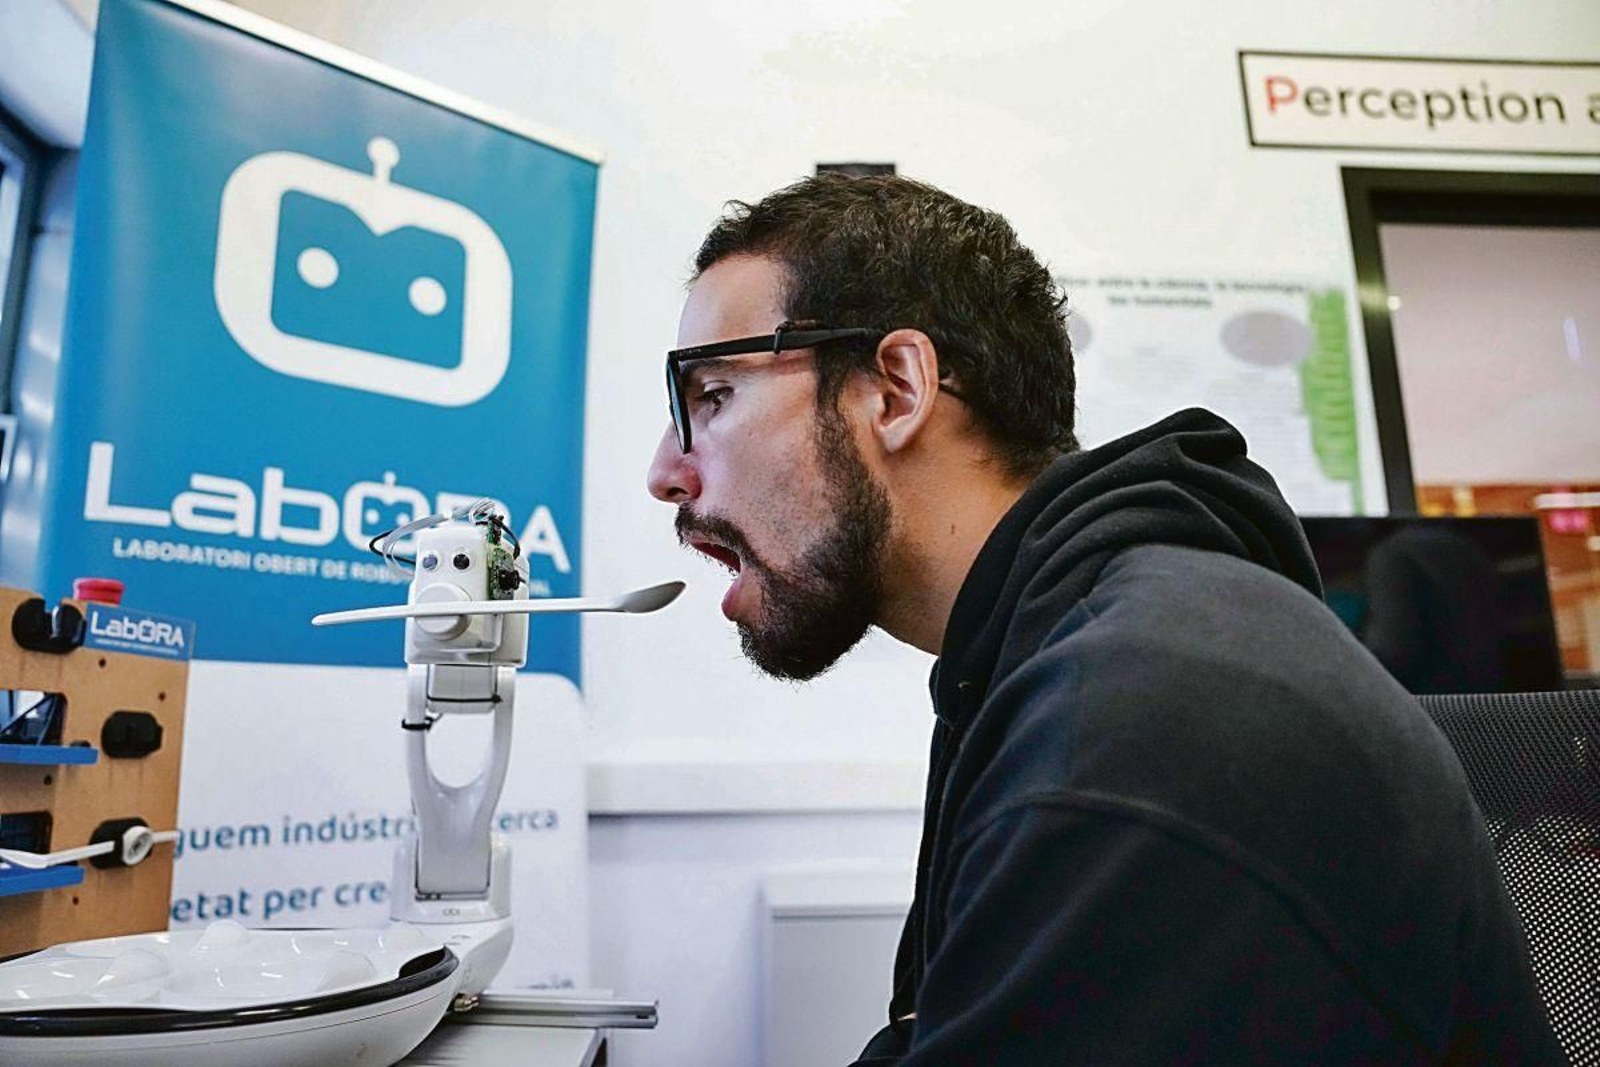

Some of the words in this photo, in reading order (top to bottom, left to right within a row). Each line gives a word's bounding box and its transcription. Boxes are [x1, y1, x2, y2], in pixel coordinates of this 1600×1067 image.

[1265, 75, 1567, 130] Perception
[112, 536, 251, 571] LABORATORI
[252, 551, 319, 577] OBERT
[320, 558, 349, 581] DE
[90, 611, 185, 649] LabORA
[282, 811, 416, 845] indústri
[498, 808, 559, 832] erca
[171, 886, 251, 922] etat
[263, 881, 324, 920] per
[334, 879, 387, 907] cre
